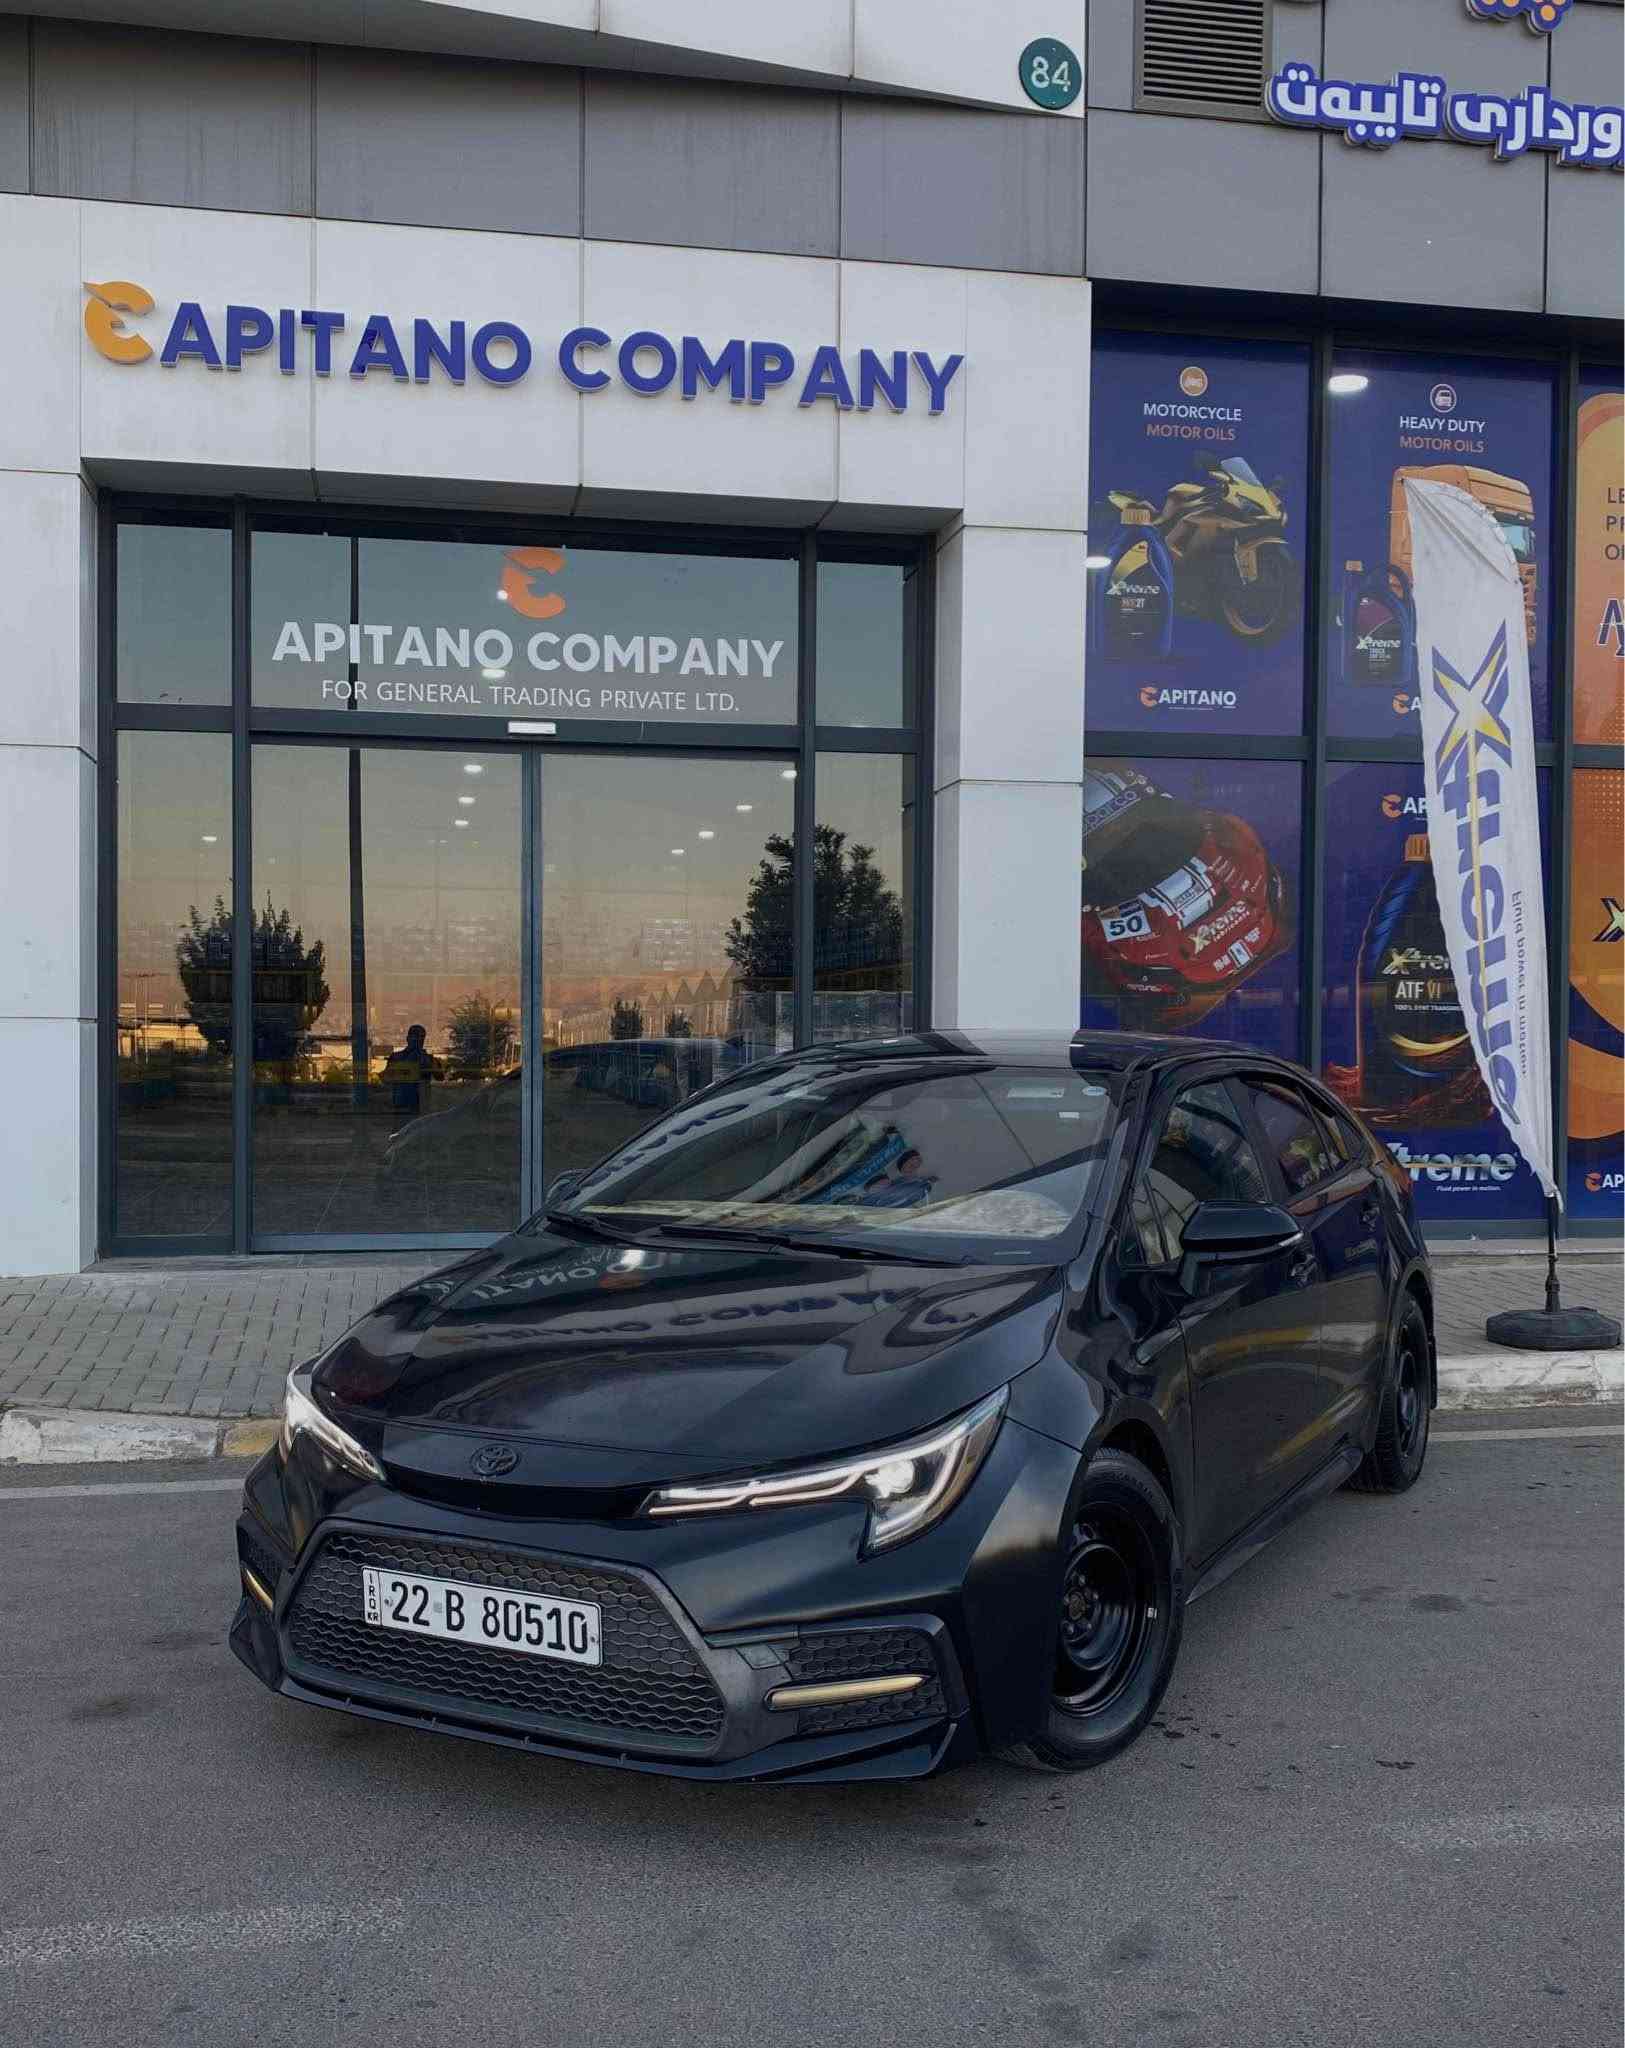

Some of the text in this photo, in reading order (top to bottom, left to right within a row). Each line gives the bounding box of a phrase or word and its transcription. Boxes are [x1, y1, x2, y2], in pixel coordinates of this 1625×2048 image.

[1031, 55, 1071, 93] 84
[557, 326, 965, 416] COMPANY
[1143, 402, 1243, 422] MOTORCYCLE
[1146, 423, 1237, 441] MOTOR OILS
[1399, 415, 1487, 433] HEAVY DUTY
[1399, 435, 1485, 454] MOTOR OILS
[271, 620, 785, 678] APITANO COMPANY
[321, 679, 740, 713] FOR GENERAL TRADING PRIVATE LTD.
[1110, 915, 1142, 936] 50
[1395, 981, 1425, 999] ATF
[391, 1581, 589, 1655] 22 B 80510
